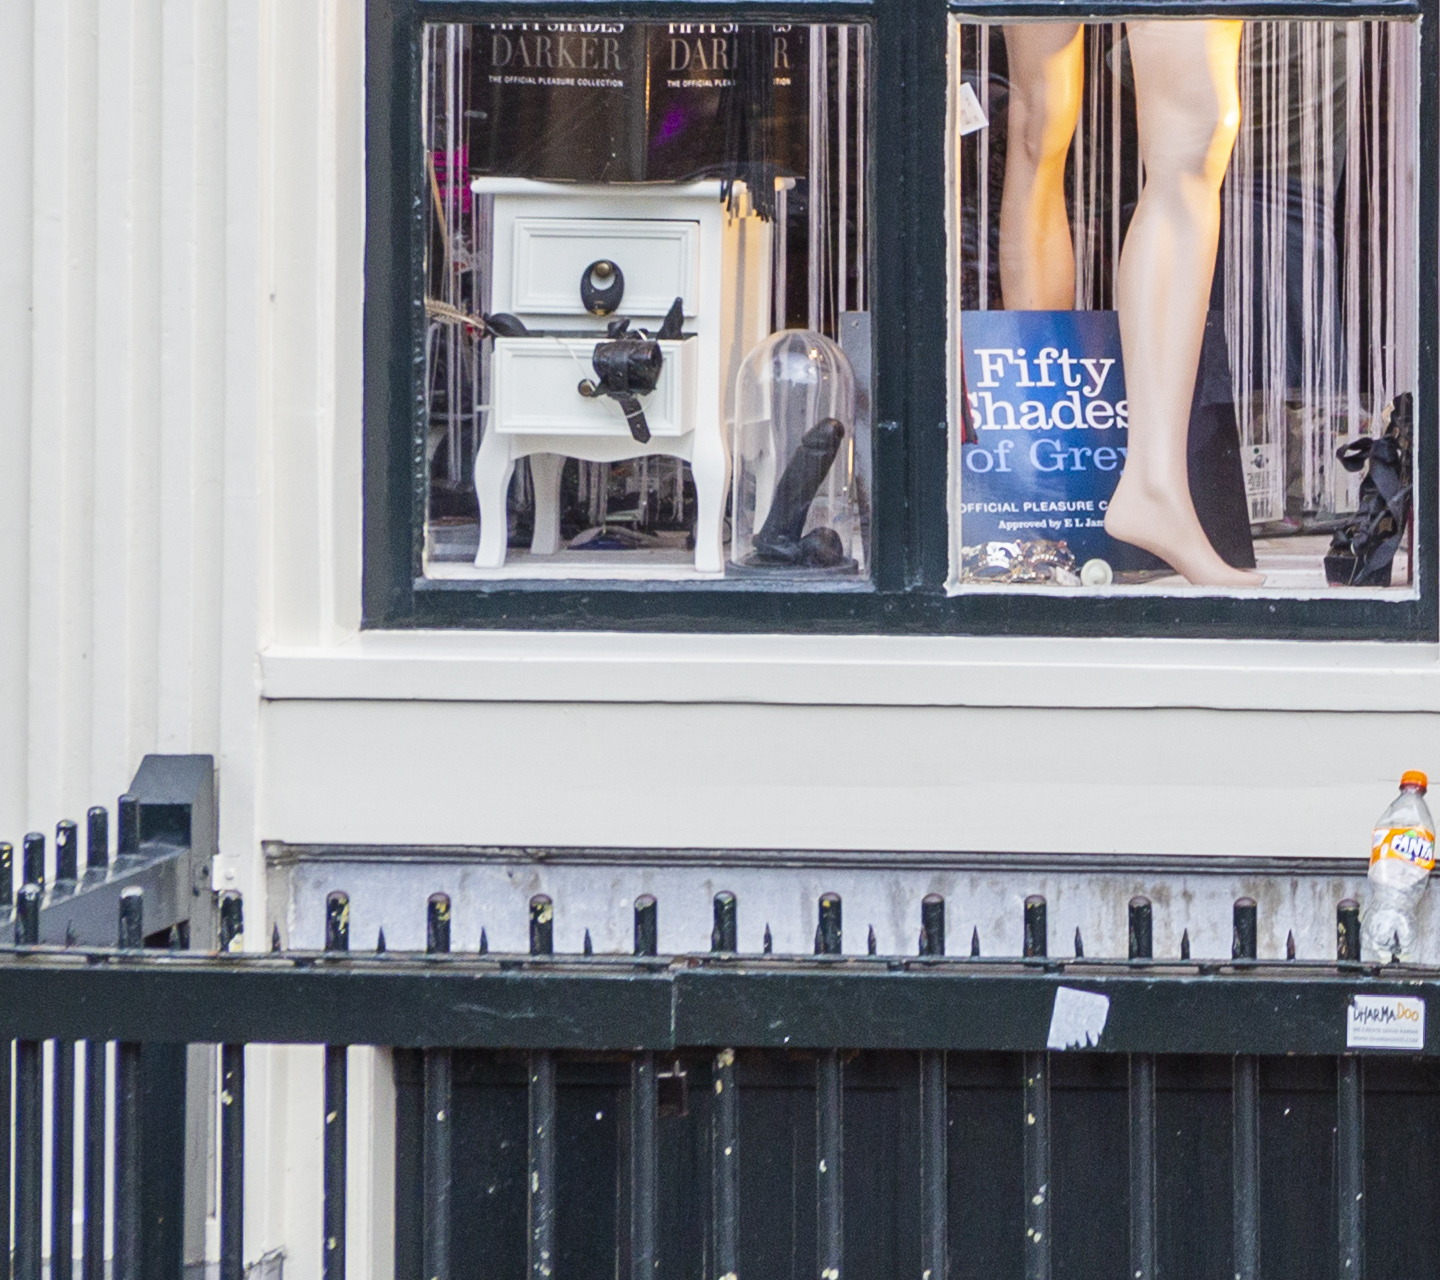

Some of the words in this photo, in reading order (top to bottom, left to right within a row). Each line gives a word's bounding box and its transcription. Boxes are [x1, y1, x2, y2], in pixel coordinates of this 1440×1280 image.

[491, 34, 628, 71] DARKER
[671, 37, 789, 70] DARR
[504, 76, 536, 85] OFFICIAL
[538, 77, 574, 86] PLEASURE
[577, 78, 623, 87] COLLECTION
[682, 79, 712, 87] OFFICIAL
[974, 347, 1116, 397] Fifty
[966, 439, 1014, 473] of
[961, 501, 1019, 513] OFFICIAL
[1023, 500, 1095, 513] PLEASURE
[998, 518, 1047, 530] Approved
[1049, 518, 1062, 530] by
[1391, 834, 1434, 861] FANTA
